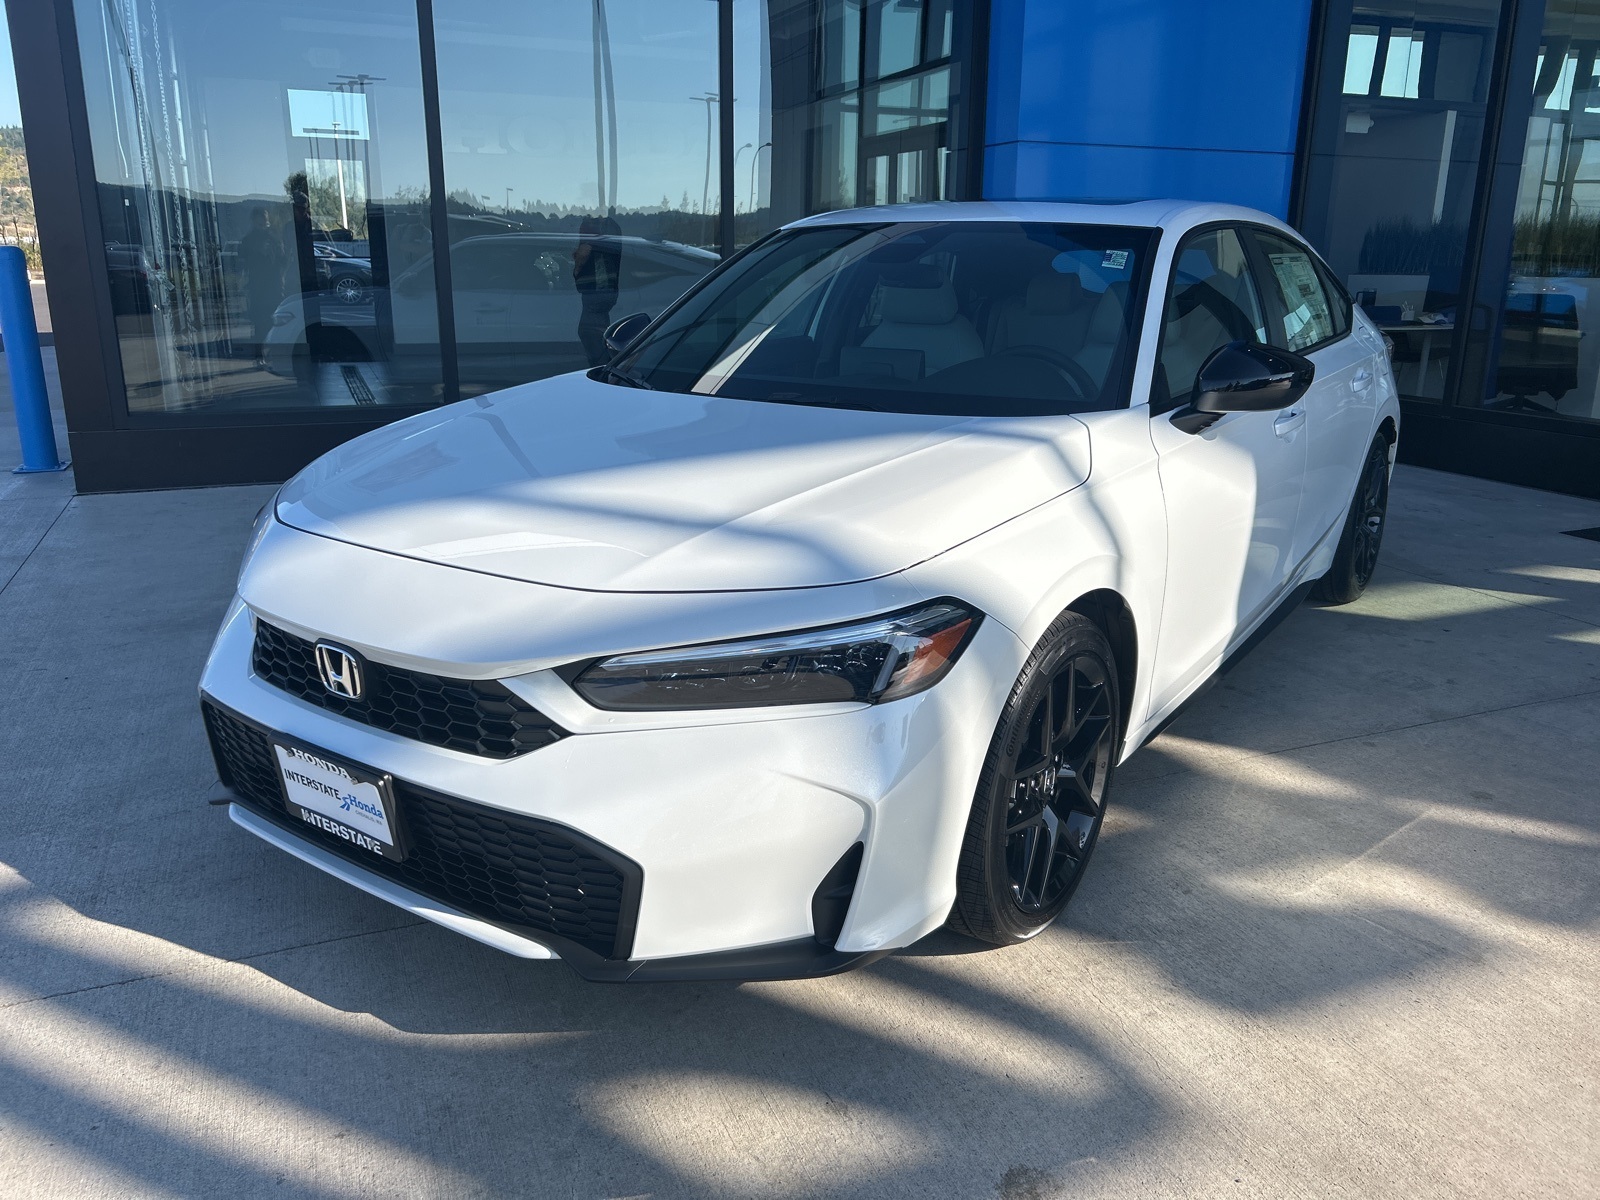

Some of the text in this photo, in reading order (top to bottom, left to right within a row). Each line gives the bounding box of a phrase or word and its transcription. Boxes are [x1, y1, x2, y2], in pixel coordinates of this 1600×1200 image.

[291, 747, 352, 780] HONDA
[284, 768, 384, 819] INTERSTATE Honda
[301, 808, 383, 855] INTERSTATE
